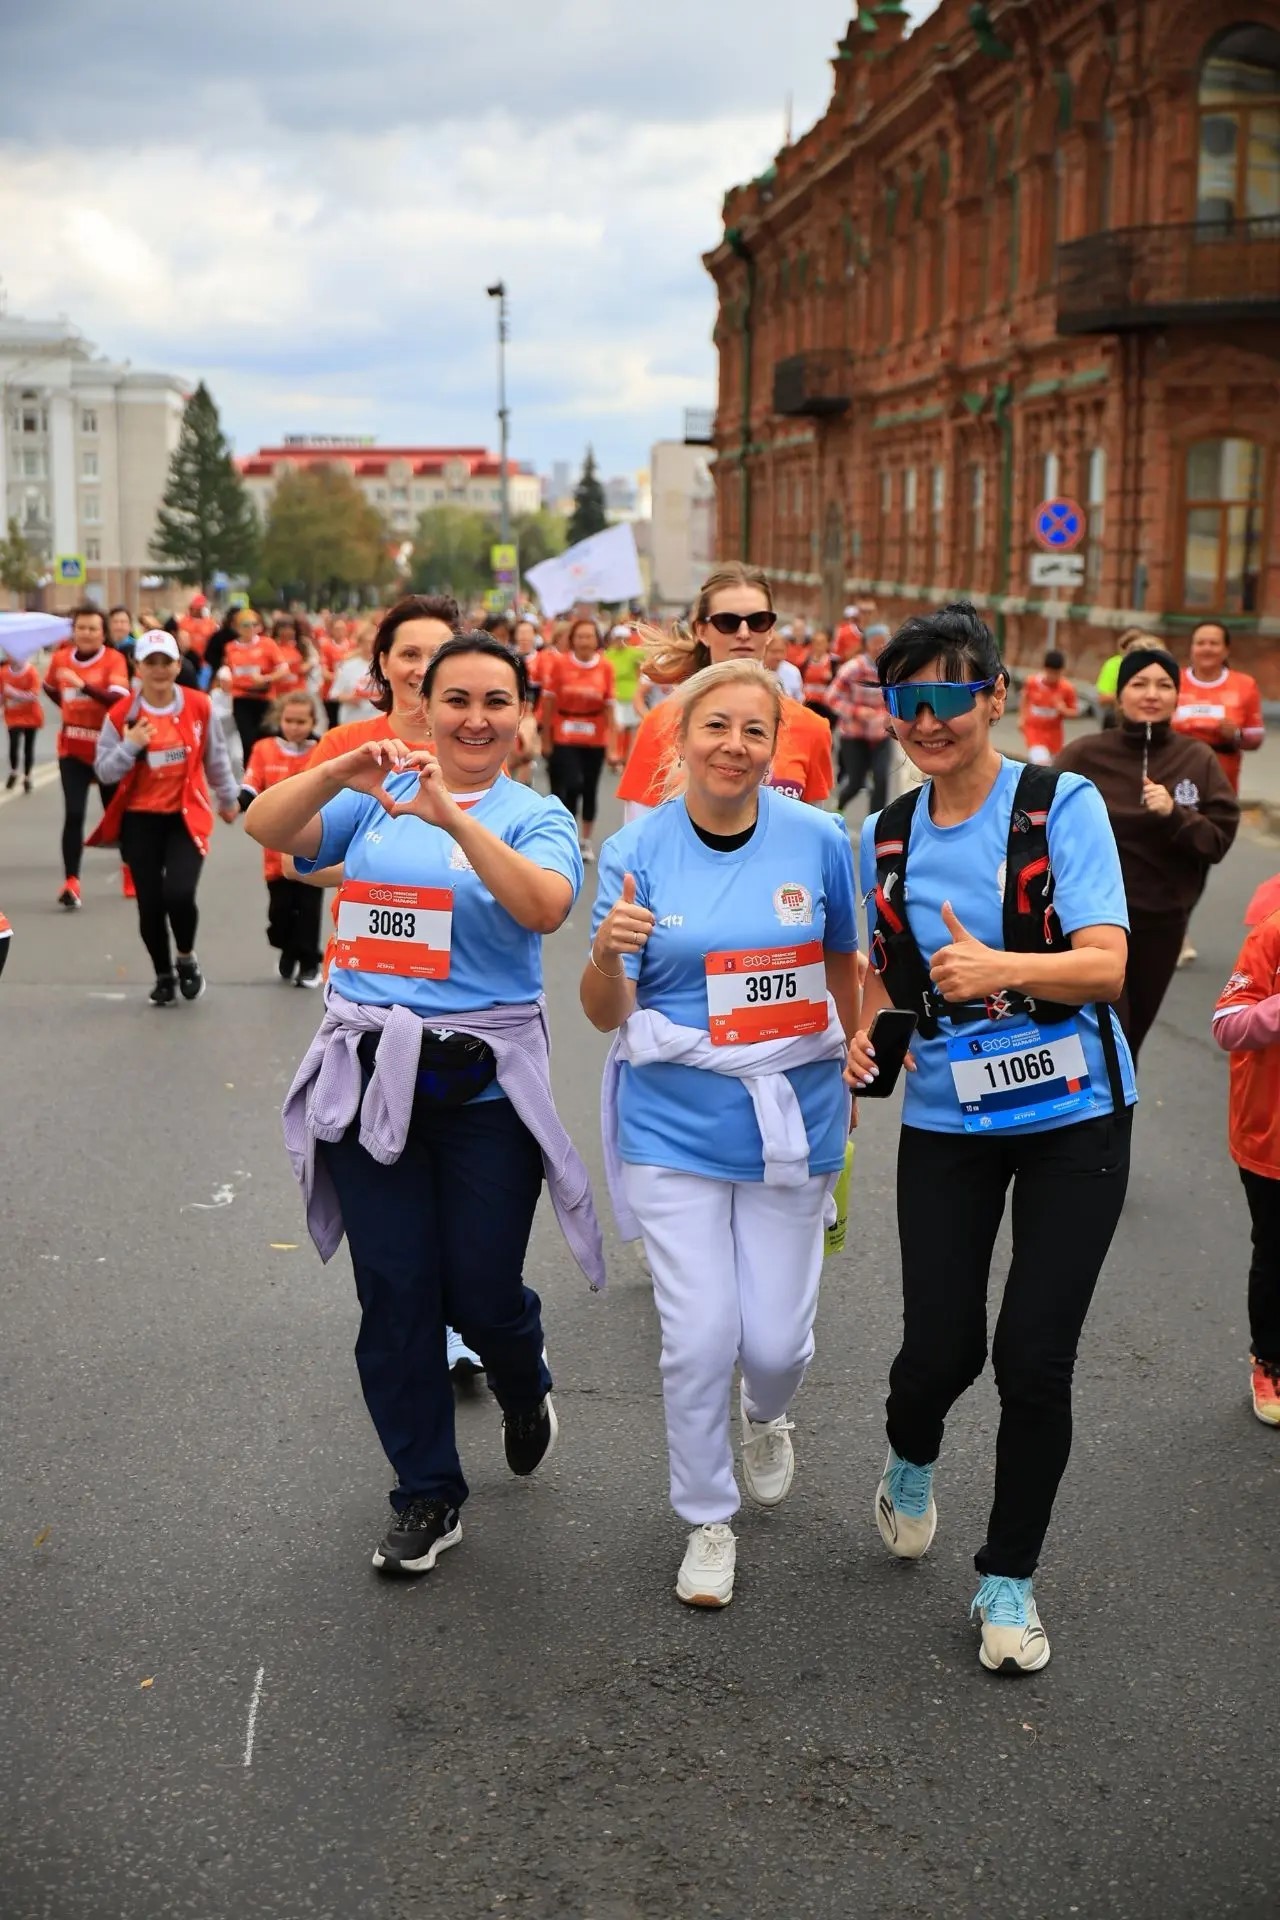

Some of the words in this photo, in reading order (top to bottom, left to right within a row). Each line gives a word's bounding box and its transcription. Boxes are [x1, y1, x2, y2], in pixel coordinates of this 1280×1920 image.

[368, 909, 416, 938] 3083
[745, 972, 797, 1003] 3975
[1012, 1036, 1041, 1047] МАРАФОН
[984, 1049, 1055, 1088] 11066
